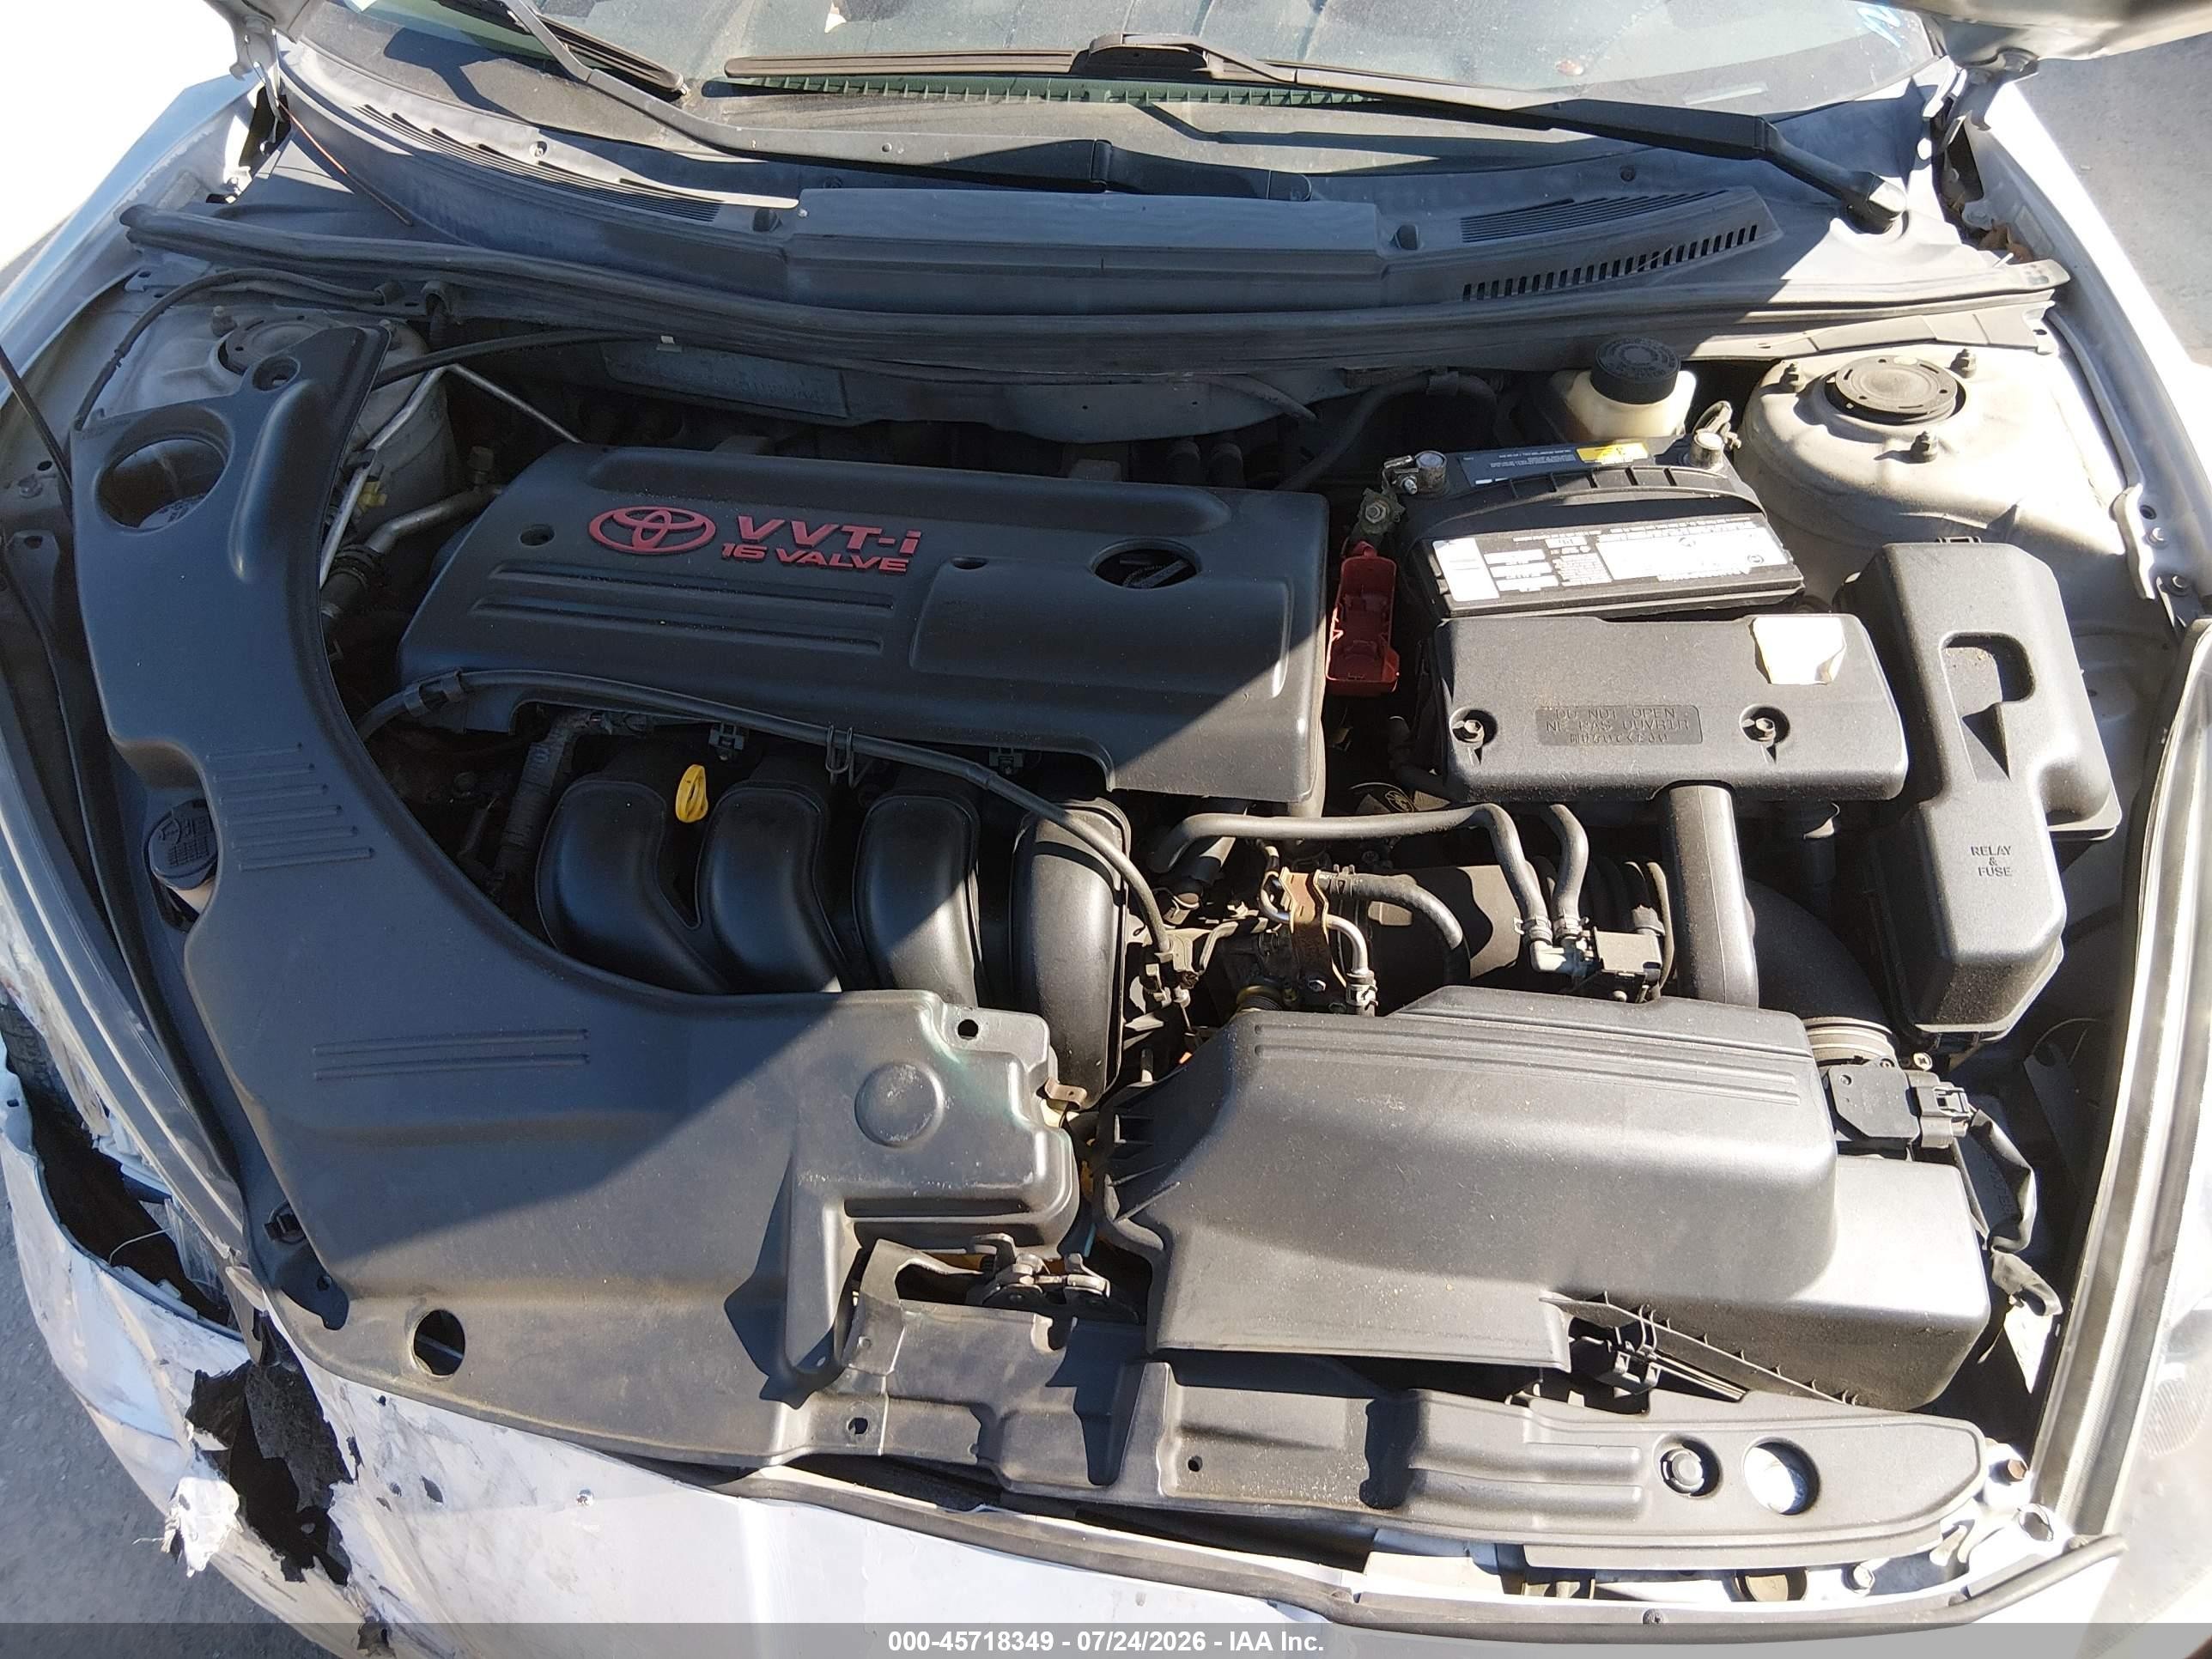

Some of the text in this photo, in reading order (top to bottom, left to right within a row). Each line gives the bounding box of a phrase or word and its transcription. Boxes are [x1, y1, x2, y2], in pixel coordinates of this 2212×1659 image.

[737, 515, 921, 556] VVT-i
[721, 542, 910, 574] 16 VALVE
[1588, 708, 1617, 720] NOT
[1632, 708, 1675, 720] OPEN
[1578, 720, 1613, 732] PAS
[1622, 720, 1689, 731] OUVRIR
[1970, 845, 2011, 856] RELAY
[1989, 856, 1997, 866] &
[1978, 866, 2012, 877] FUSE
